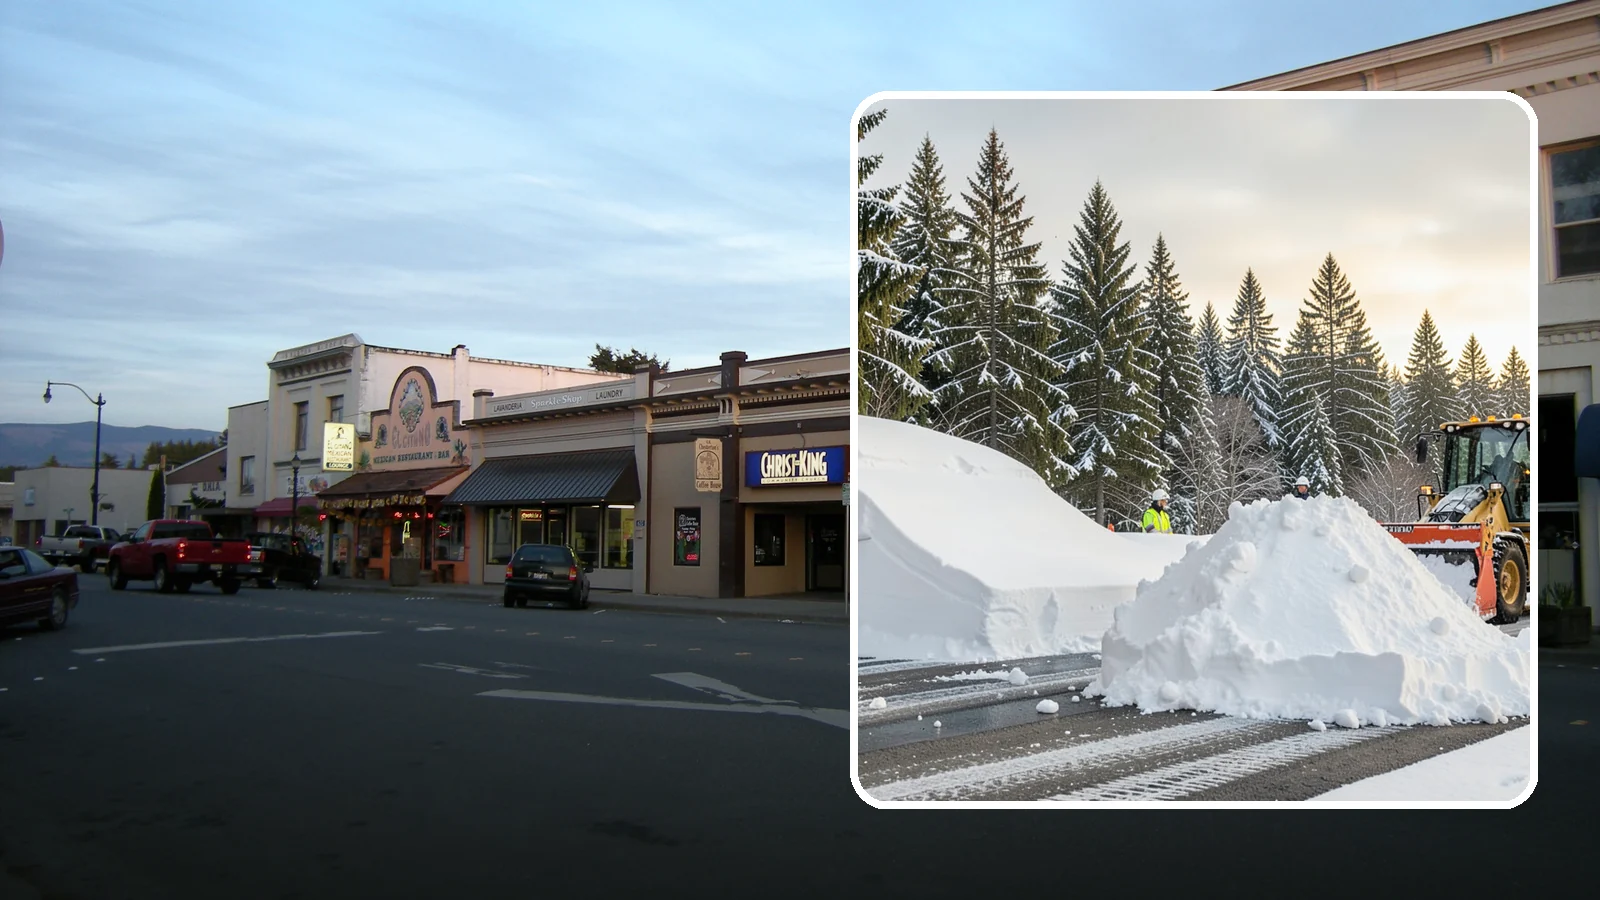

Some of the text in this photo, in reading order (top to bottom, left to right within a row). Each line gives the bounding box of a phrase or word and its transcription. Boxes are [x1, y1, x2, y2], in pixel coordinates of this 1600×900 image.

[530, 394, 582, 410] Sparkle Shop
[595, 389, 624, 400] LAUNDRY
[493, 402, 523, 412] LAVANDERIA
[373, 454, 396, 464] MEXICAN
[397, 451, 434, 463] RESTAURANT
[437, 449, 450, 459] BAR
[760, 450, 828, 478] CHRIST KING
